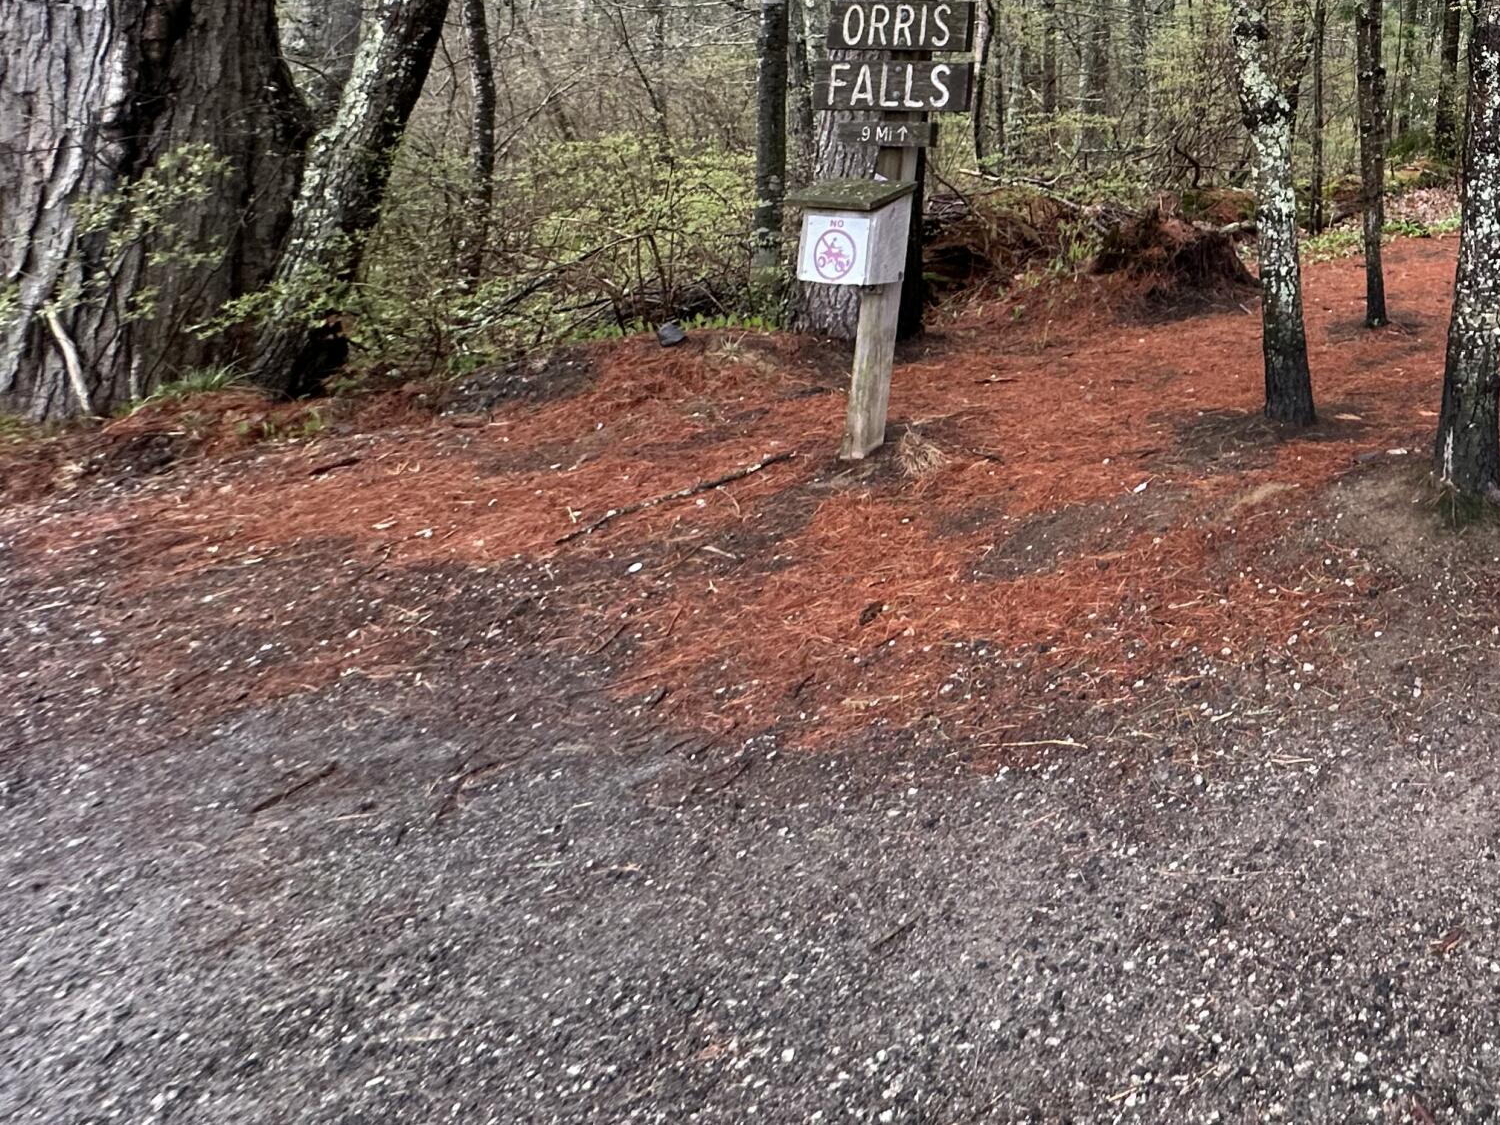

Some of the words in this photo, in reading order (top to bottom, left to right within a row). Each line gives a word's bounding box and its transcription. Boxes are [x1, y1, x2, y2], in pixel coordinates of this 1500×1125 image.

[843, 4, 951, 46] ORRIS
[828, 63, 951, 107] FALLS
[856, 126, 870, 141] .9
[830, 219, 844, 228] NO
